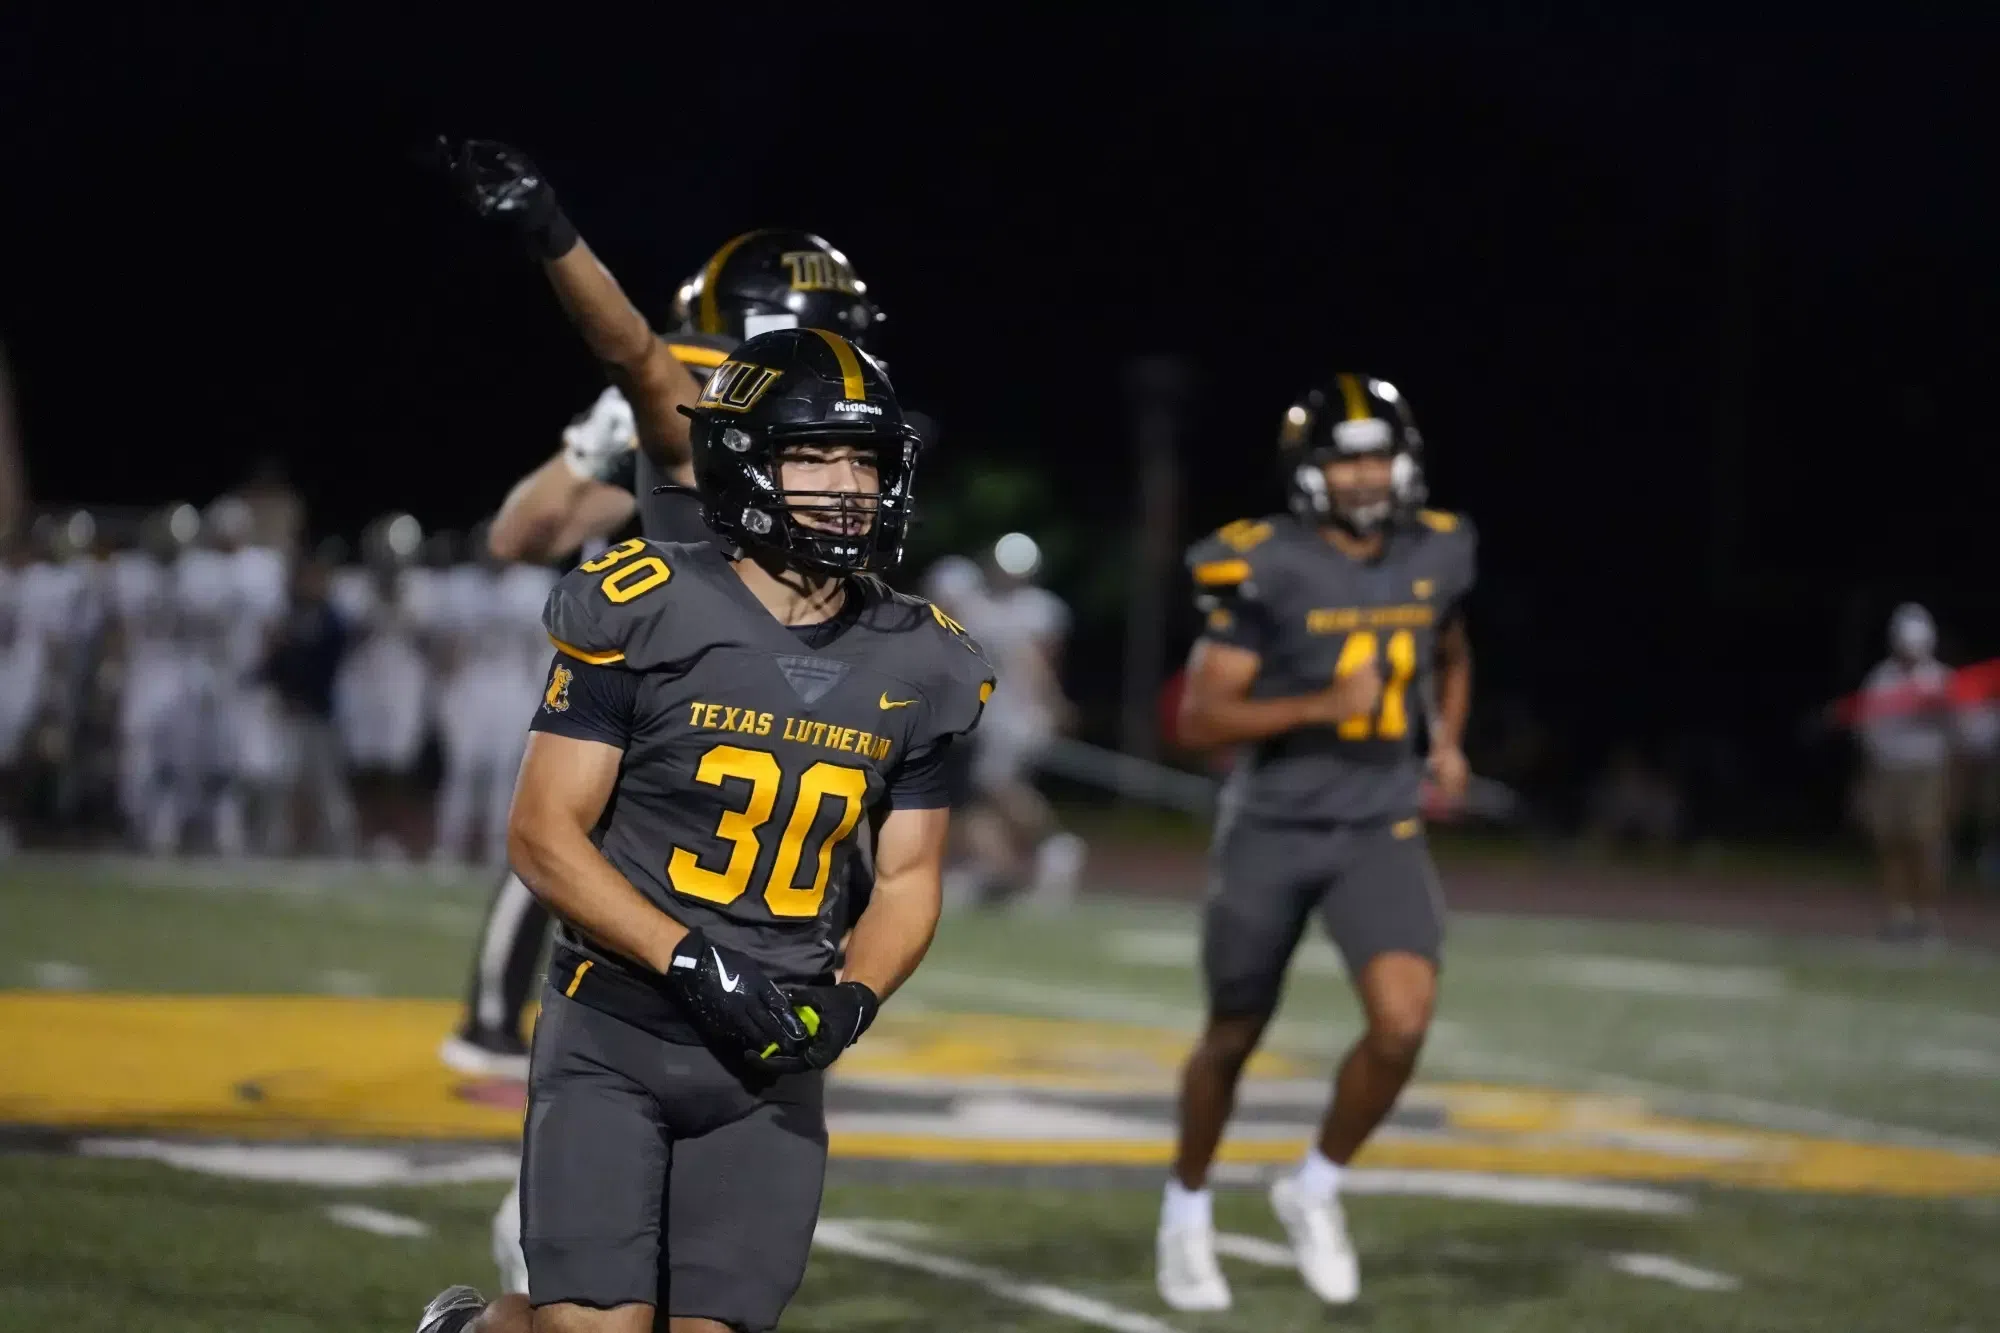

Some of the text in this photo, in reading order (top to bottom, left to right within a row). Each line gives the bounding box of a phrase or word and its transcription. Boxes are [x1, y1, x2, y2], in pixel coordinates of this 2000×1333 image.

[579, 538, 672, 604] 30
[689, 702, 774, 736] TEXAS
[667, 744, 868, 917] 30
